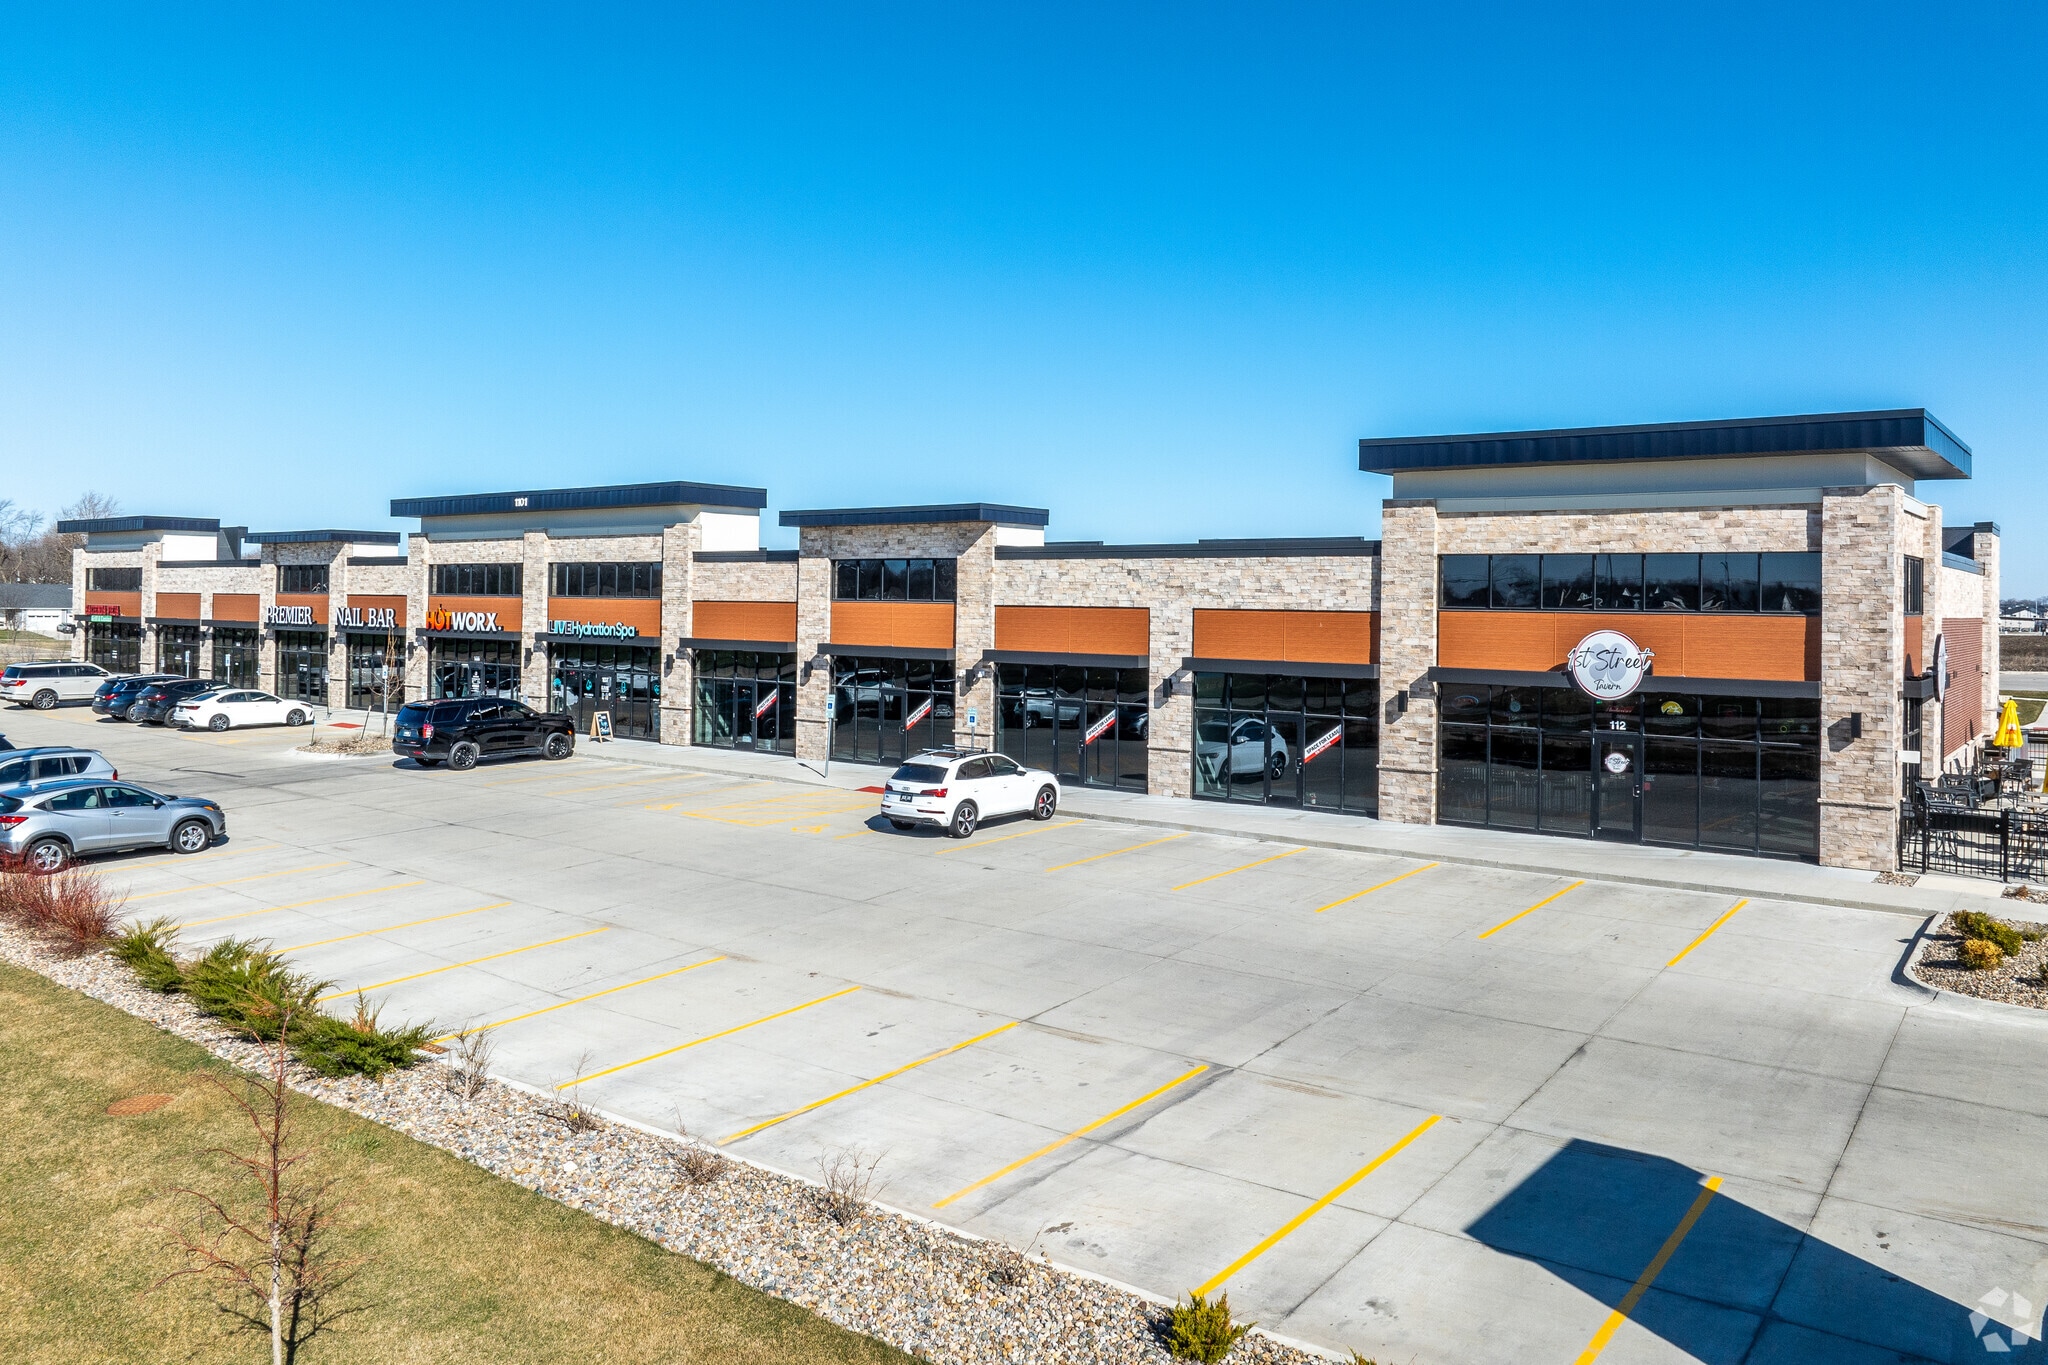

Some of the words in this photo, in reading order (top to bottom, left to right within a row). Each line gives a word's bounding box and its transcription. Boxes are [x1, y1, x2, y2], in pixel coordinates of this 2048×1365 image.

[265, 606, 313, 625] PREMIER
[336, 607, 364, 627] NAIL
[368, 608, 395, 628] BAR
[1568, 647, 1595, 671] 1st
[1595, 647, 1655, 672] Street
[1594, 678, 1622, 691] Tavern
[1609, 720, 1627, 731] 112
